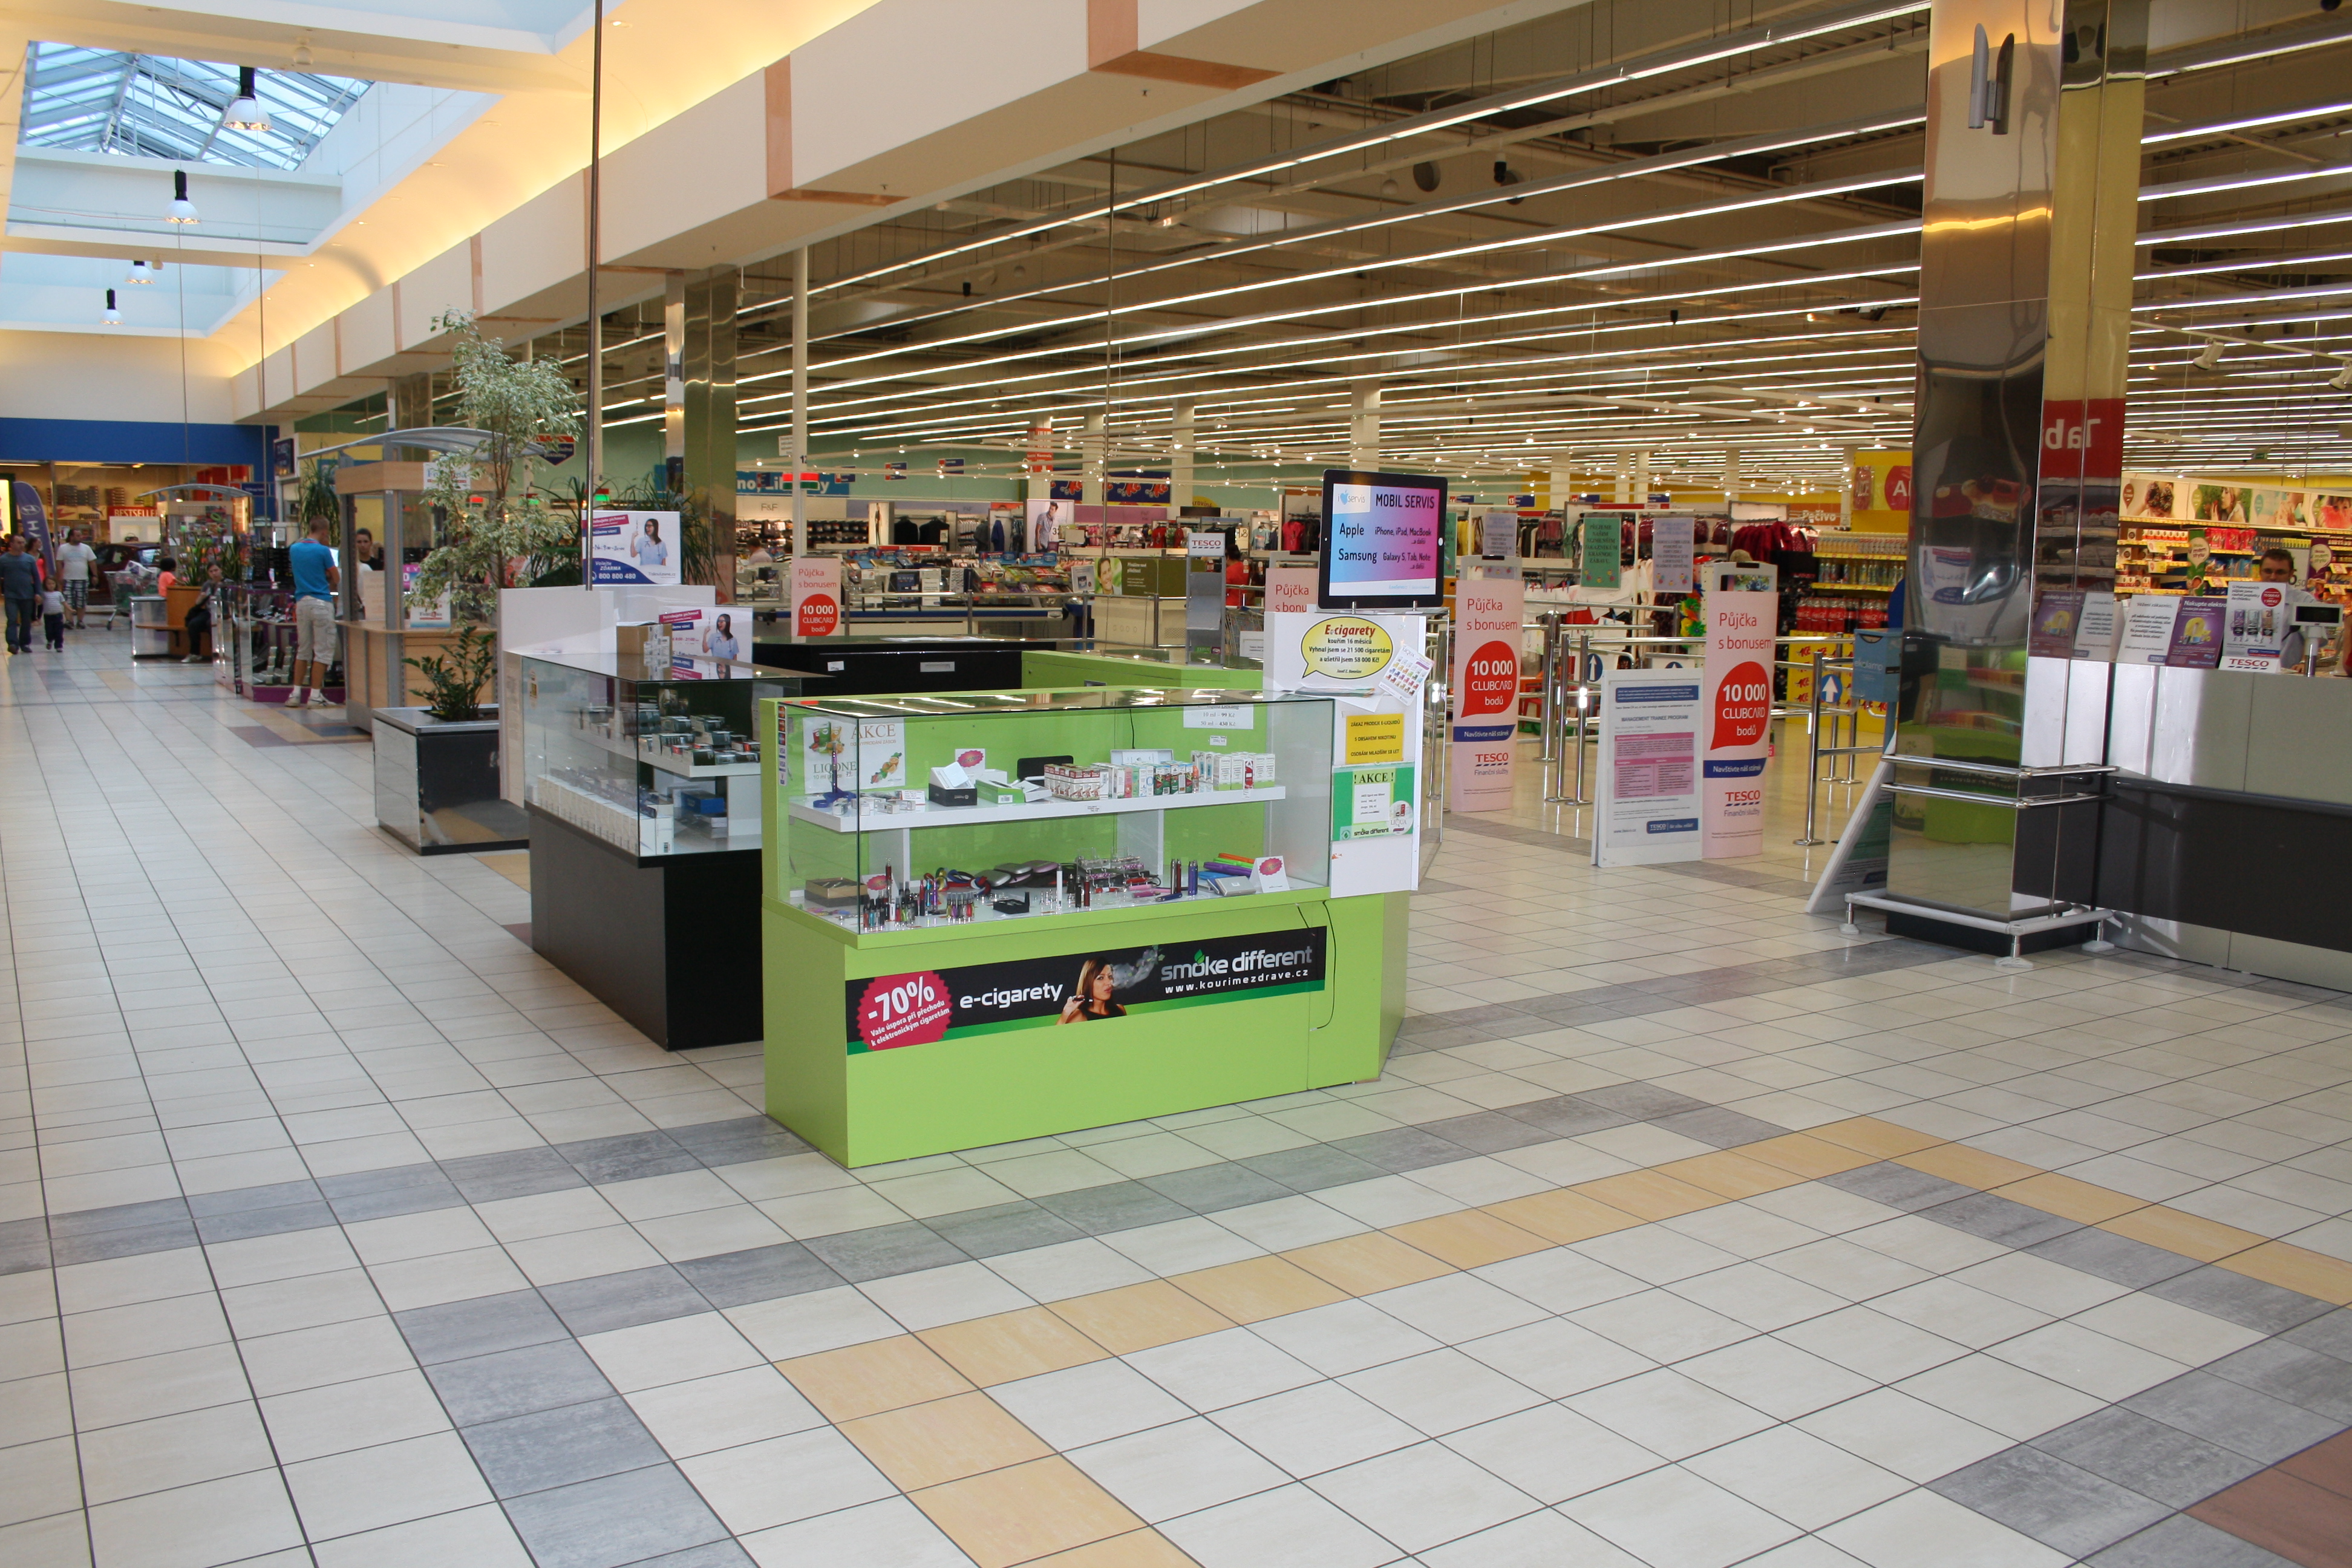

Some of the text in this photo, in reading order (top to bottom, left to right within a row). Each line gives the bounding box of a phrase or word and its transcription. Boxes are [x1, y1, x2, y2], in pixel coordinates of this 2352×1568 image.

[1348, 495, 1365, 503] servis
[1376, 494, 1435, 509] MOBIL SERVIS
[1802, 510, 1837, 521] Pečivo
[1339, 523, 1431, 538] Apple iPhone, iPad, MacBook
[1338, 548, 1377, 564] Samsung
[1383, 552, 1401, 563] Galaxy
[799, 569, 825, 578] Půjčka
[1275, 584, 1309, 597] Půjčka
[802, 605, 834, 615] 10 000
[1467, 598, 1503, 613] Půjčka
[1466, 618, 1518, 630] s bonusem
[1719, 612, 1757, 630] Půjčka
[1325, 624, 1376, 638] Ecigarety
[1718, 636, 1771, 649] s bonusem
[1471, 660, 1513, 676] 10 000
[2229, 658, 2269, 667] TESCO
[1472, 681, 1513, 691] CLUBCARD
[1723, 684, 1766, 702] 10 000
[1485, 696, 1504, 705] bodů
[1722, 707, 1765, 719] CLUBCARD
[851, 724, 896, 739] AKCE
[1737, 725, 1756, 736] bodů
[1475, 753, 1509, 762] TESCO
[1359, 773, 1388, 783] AKCE
[1725, 790, 1760, 802] TESCO
[1370, 827, 1389, 835] different
[1161, 946, 1313, 981] smoke different
[1165, 969, 1308, 994] www.kourimezdrave.cz
[868, 976, 935, 1022] -70%
[959, 982, 1063, 1008] e-cigarety
[871, 999, 945, 1037] Vaše úspora při přechodu
[877, 1022, 920, 1045] elektronickým
[920, 1008, 950, 1027] cigaretám
